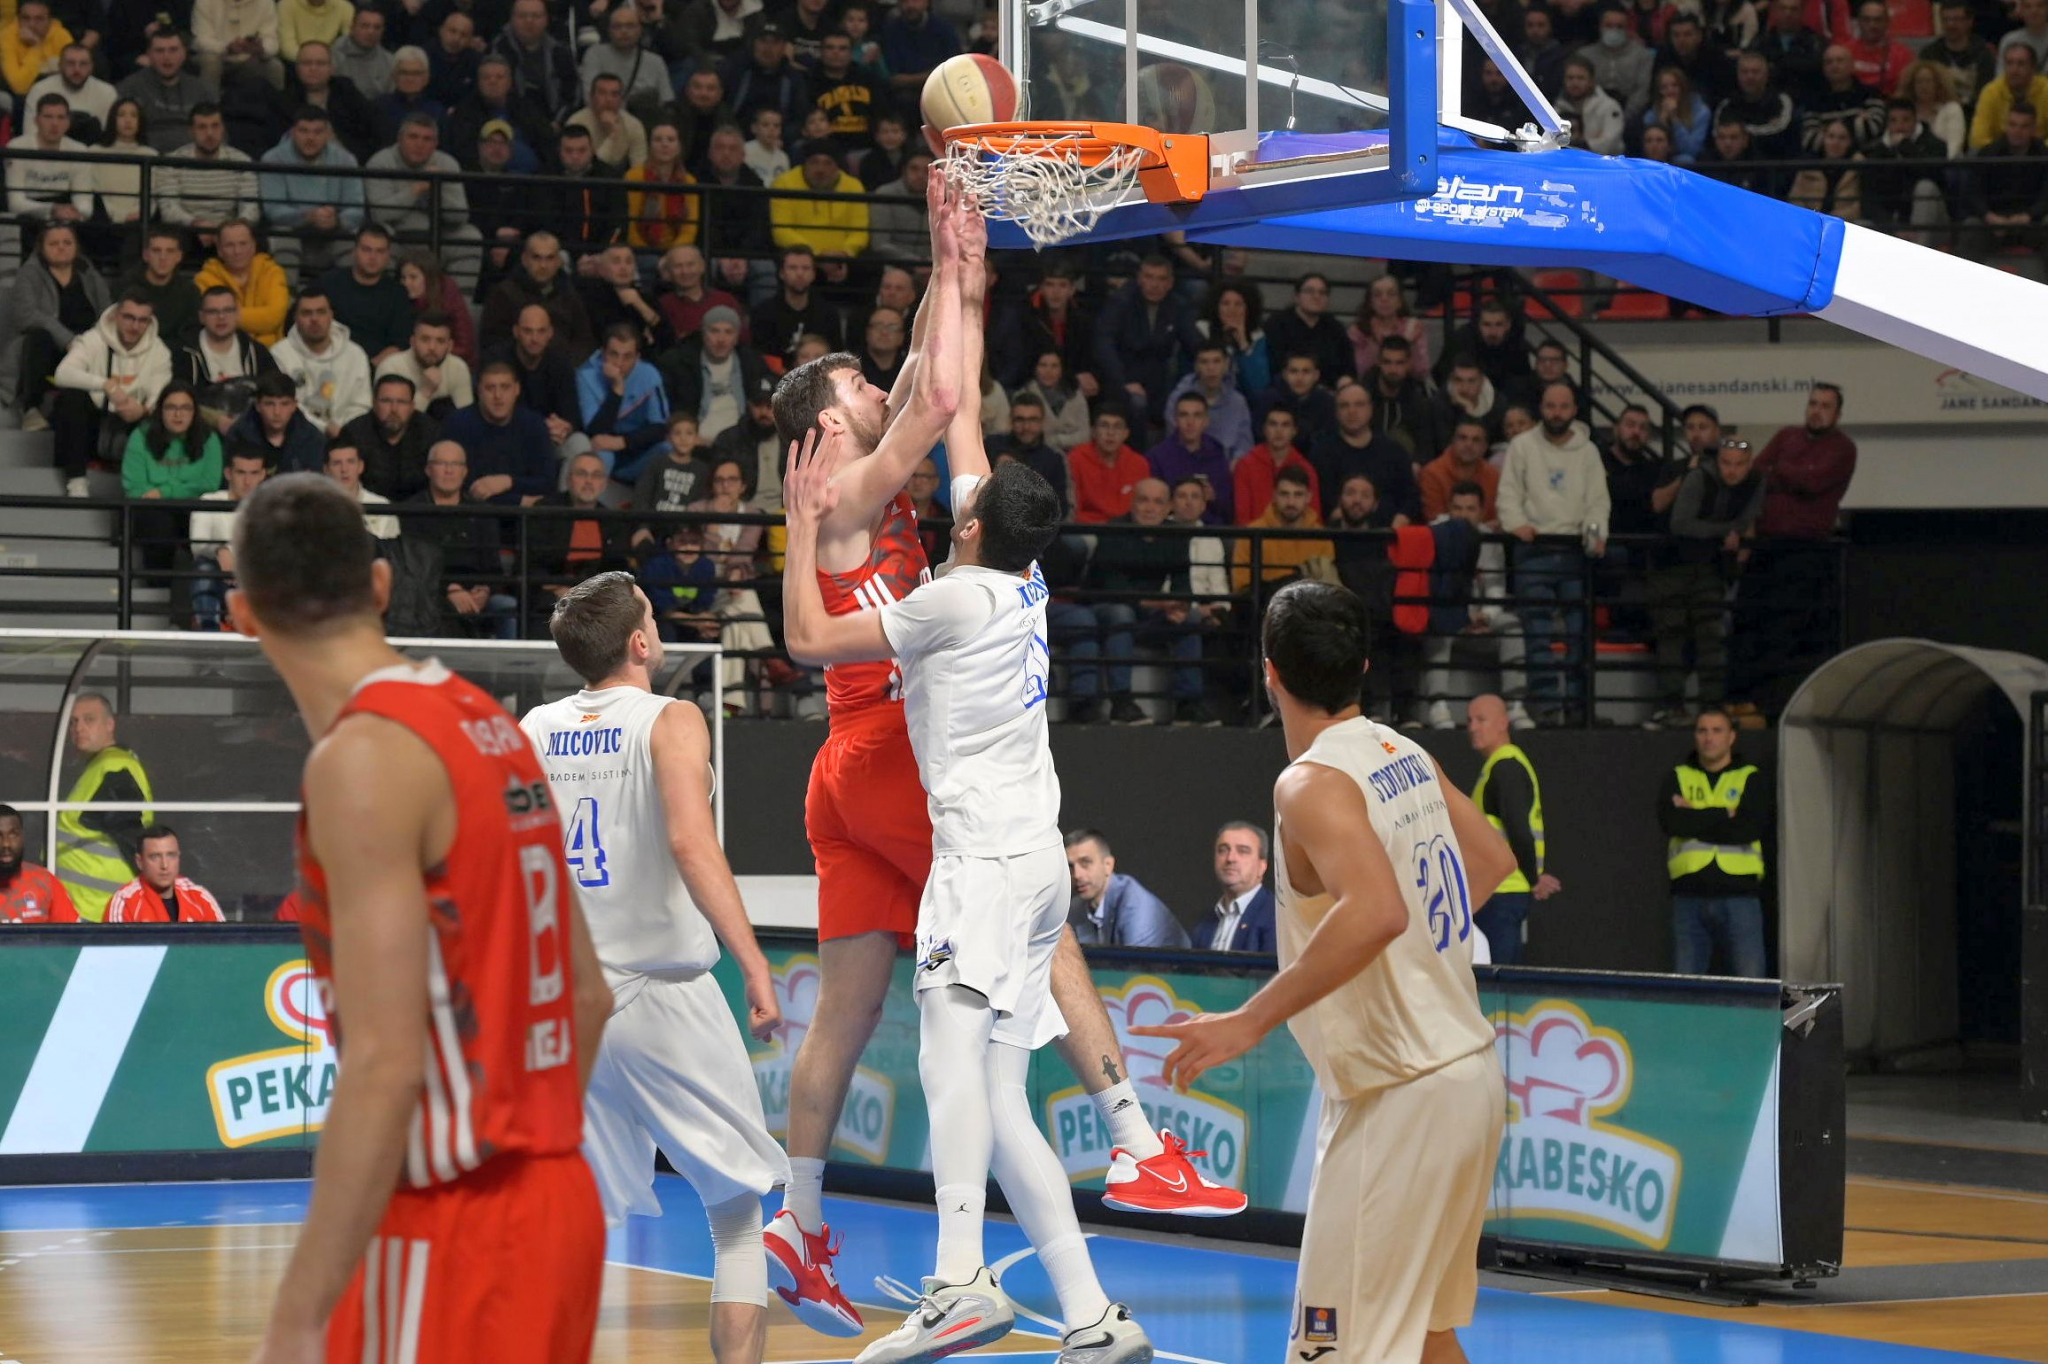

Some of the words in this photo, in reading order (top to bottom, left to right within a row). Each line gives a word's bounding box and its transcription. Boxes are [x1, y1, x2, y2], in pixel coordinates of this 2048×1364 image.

[546, 727, 622, 757] MICOVIC
[564, 797, 610, 888] 4
[1412, 834, 1471, 954] 20
